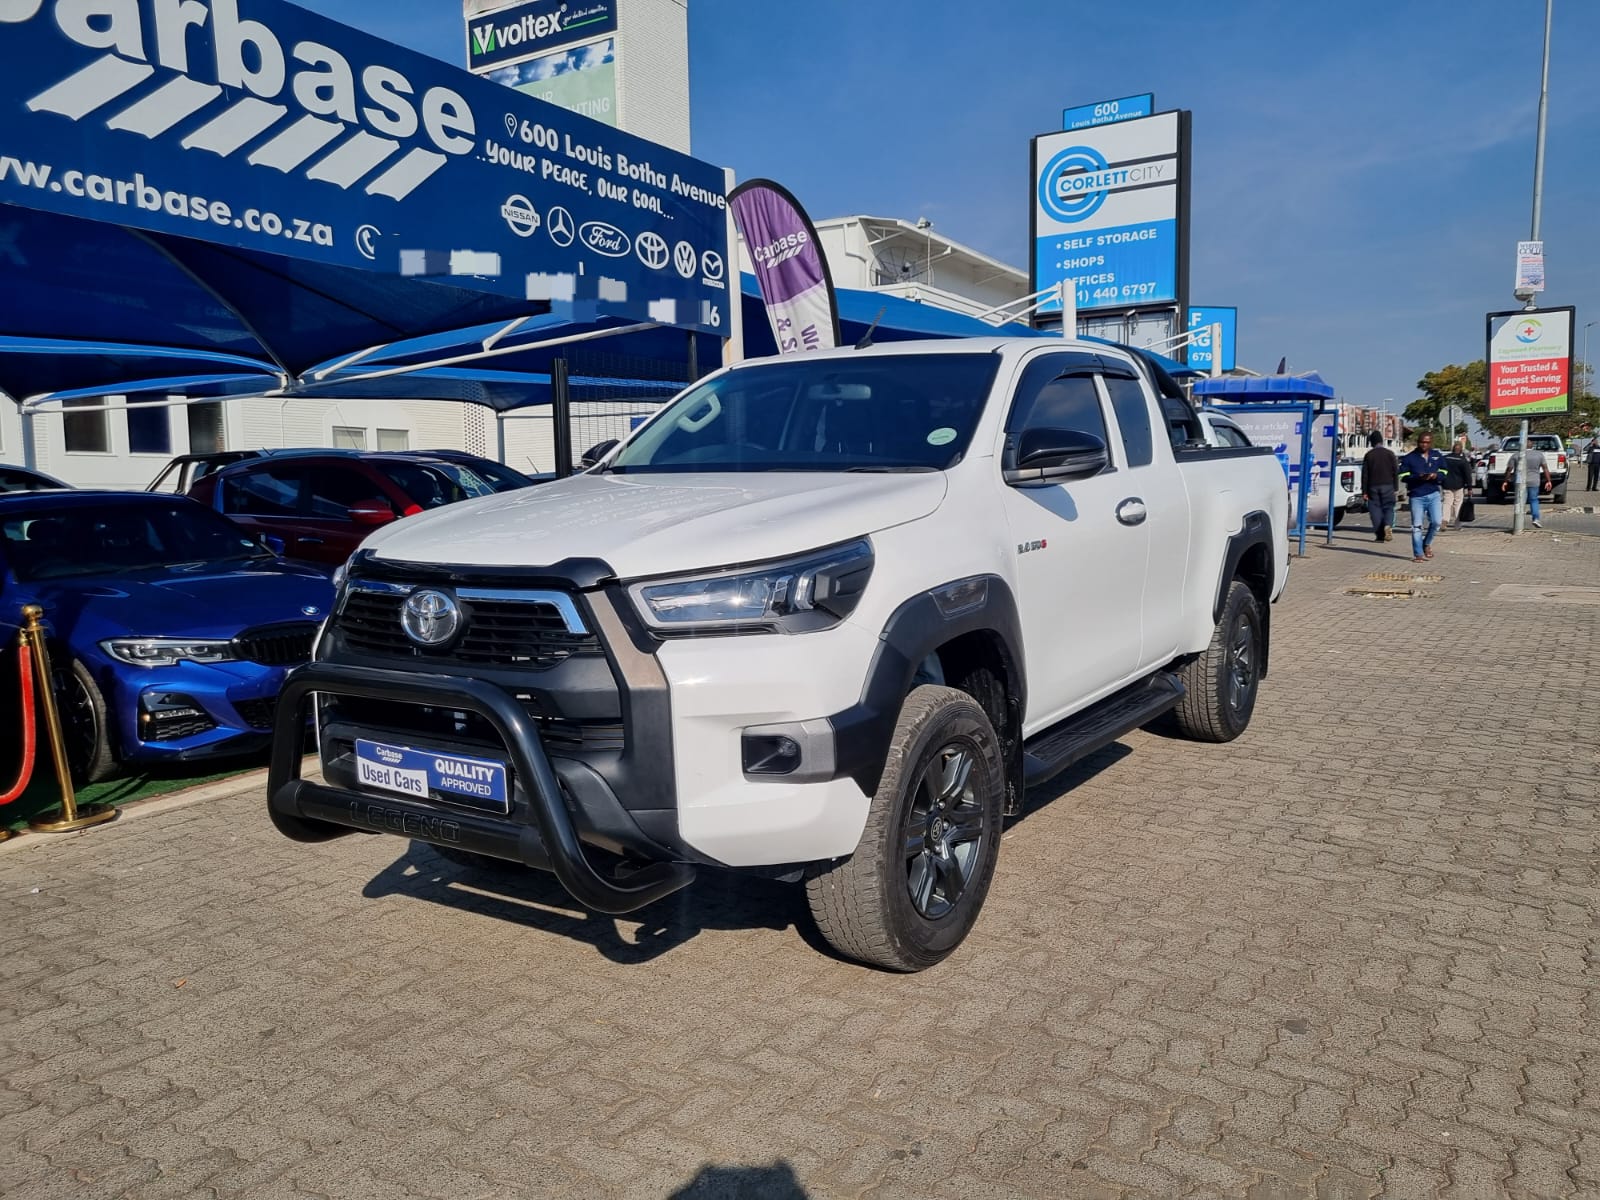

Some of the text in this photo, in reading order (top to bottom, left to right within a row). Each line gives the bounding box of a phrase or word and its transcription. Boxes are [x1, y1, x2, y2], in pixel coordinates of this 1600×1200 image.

[496, 11, 562, 48] voltex
[0, 0, 476, 155] arbase
[1071, 117, 1091, 129] Louis
[1114, 109, 1142, 121] Avenue
[1094, 101, 1119, 117] 600
[520, 120, 726, 209] 600 Louis Botha Avenue
[542, 158, 593, 196] PEACE,
[597, 177, 628, 203] OUR
[0, 155, 333, 247] w.carbase.co.za
[503, 208, 539, 224] NISSAN
[588, 226, 621, 251] Ford
[1063, 228, 1157, 250] SELF STORAGE
[753, 231, 807, 262] Carbase
[1063, 255, 1105, 270] SHOPS
[1064, 272, 1115, 288] FFICES
[1093, 286, 1118, 300] 440
[1122, 282, 1156, 297] 6797
[1192, 352, 1212, 362] 679
[1501, 361, 1558, 374] Your Trusted &
[1497, 374, 1561, 386] Longest Serving
[1497, 386, 1560, 397] Local Pharmacy
[376, 746, 403, 760] Carbase
[362, 763, 422, 793] Used Cars
[434, 758, 494, 783] QUALITY
[441, 777, 492, 796] APPROVED
[350, 800, 461, 843] LEGEND
